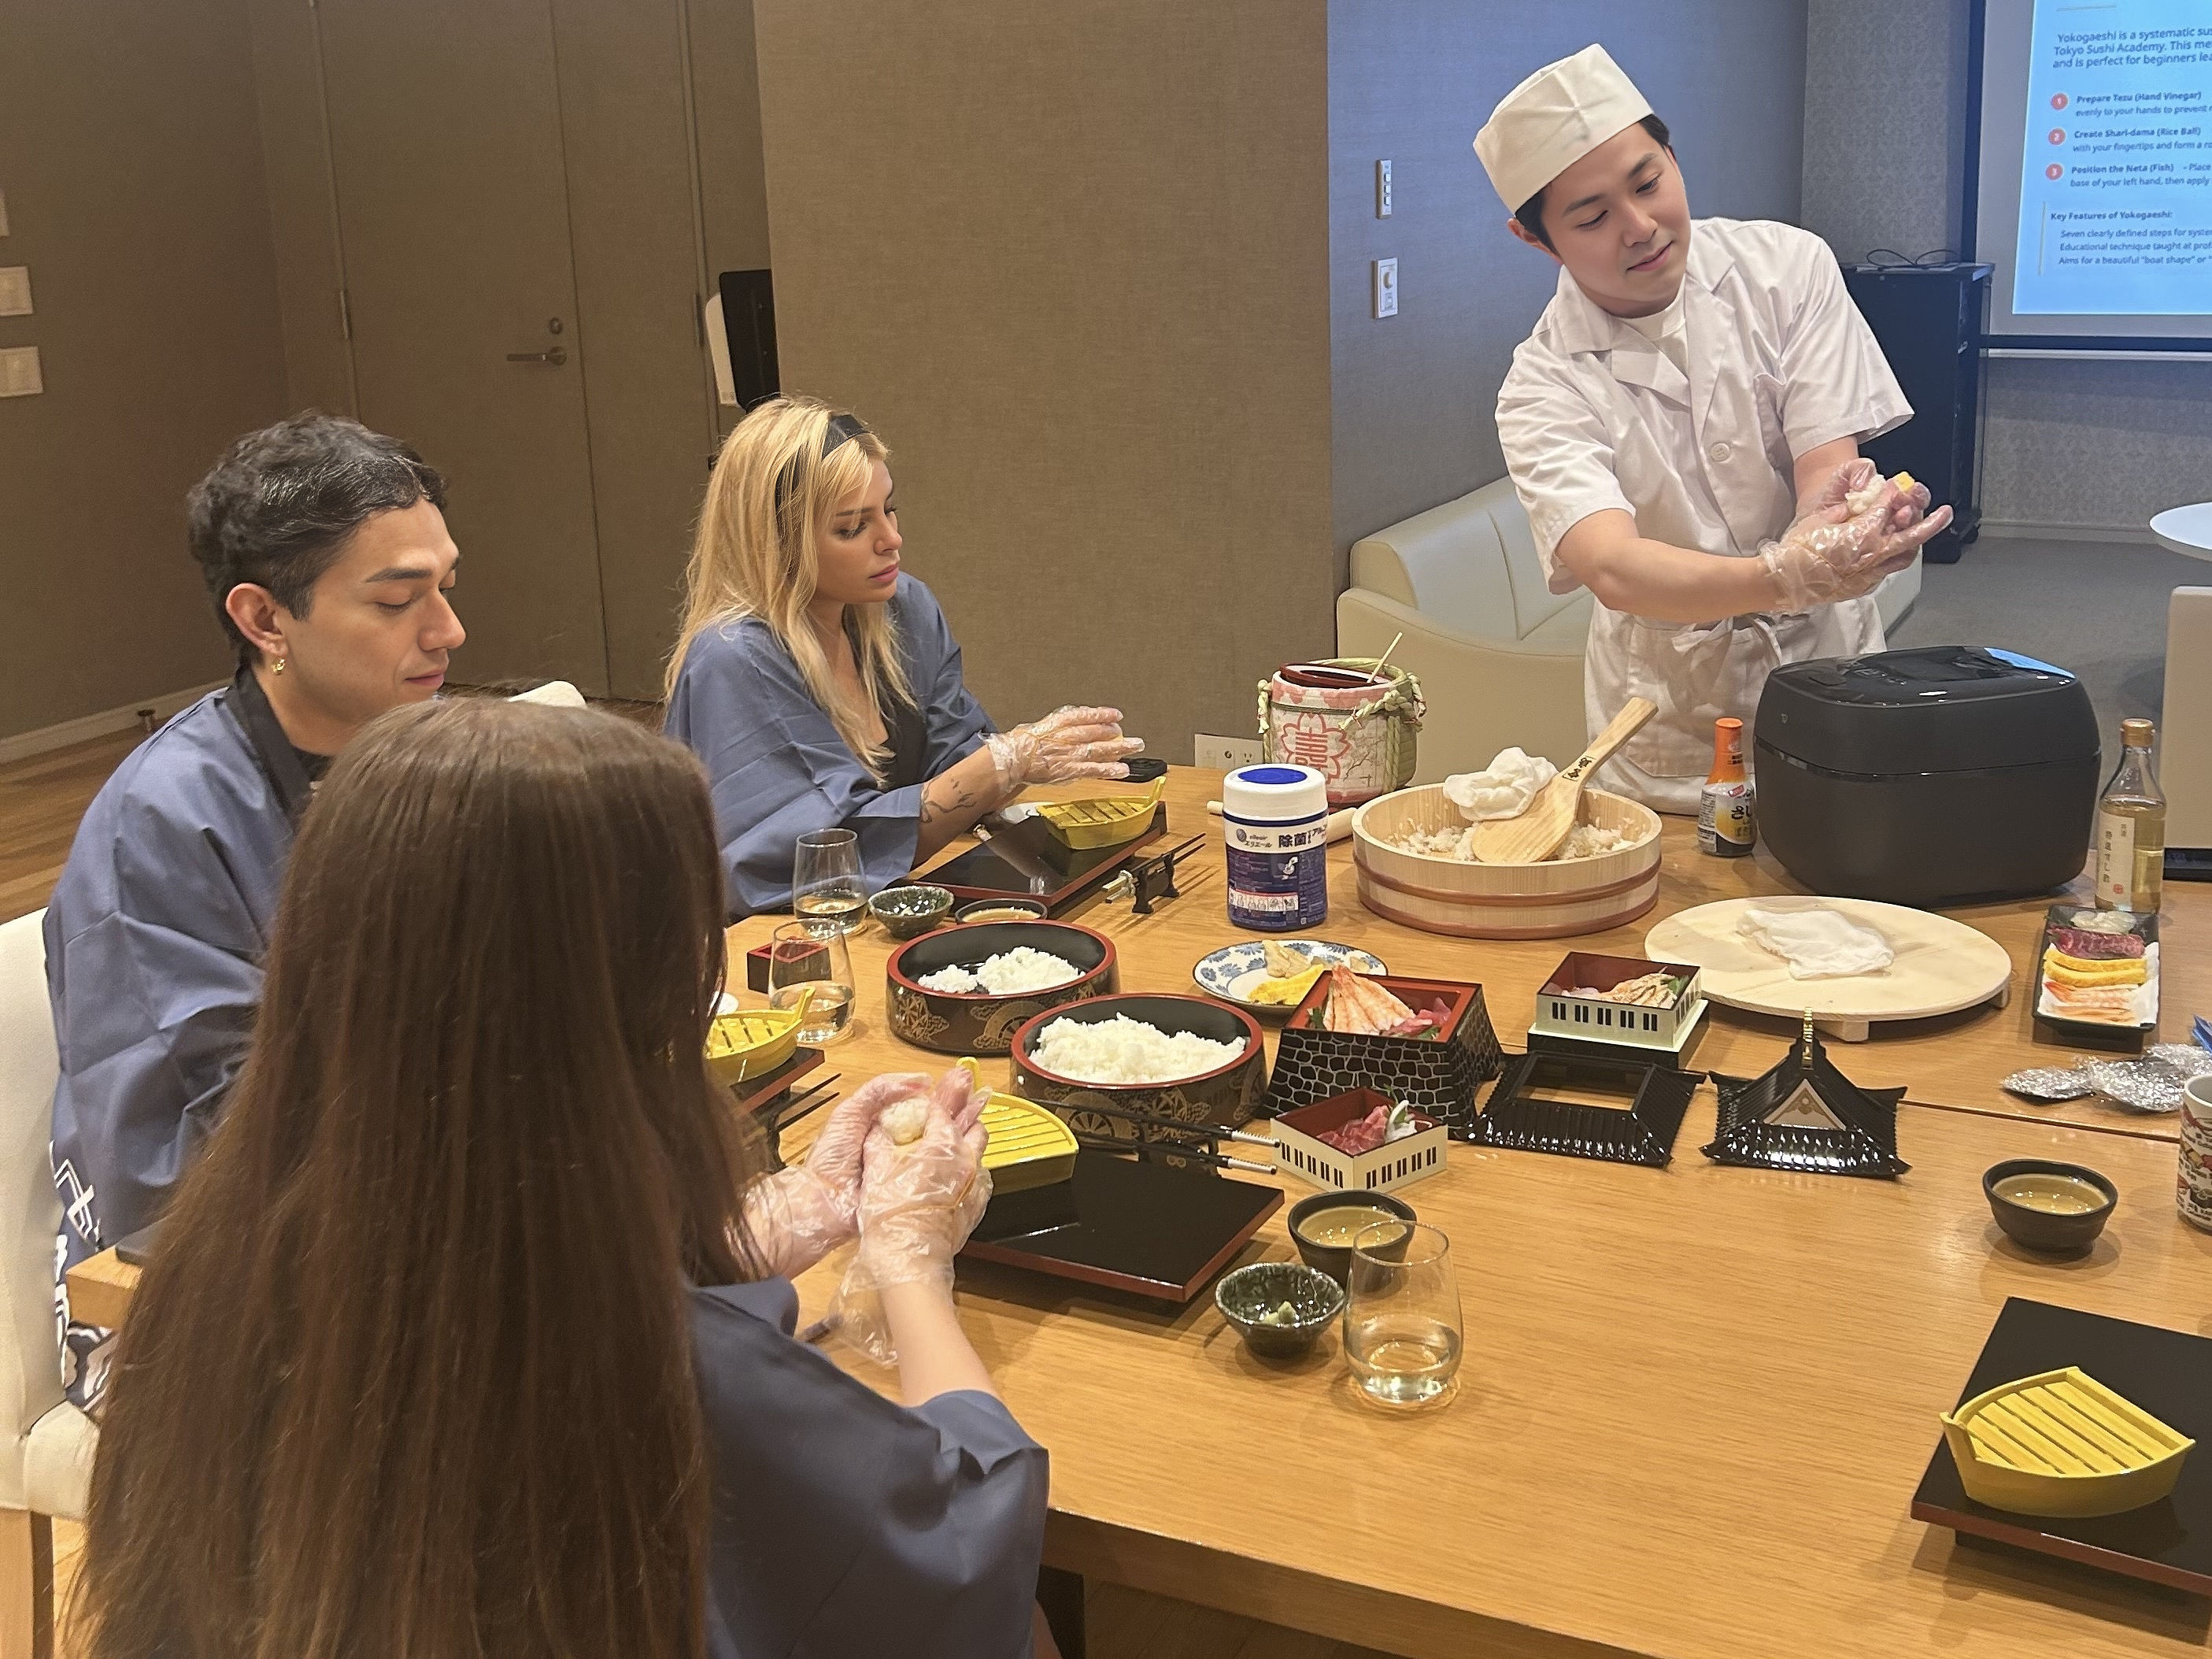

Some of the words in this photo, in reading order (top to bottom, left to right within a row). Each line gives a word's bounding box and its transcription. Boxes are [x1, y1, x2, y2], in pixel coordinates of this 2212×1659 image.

[2058, 31, 2117, 44] Yokogaeshi
[2139, 28, 2195, 41] systematic
[2054, 46, 2084, 57] Tokyo
[2087, 44, 2114, 54] Sushi
[2170, 40, 2192, 50] This
[2053, 58, 2073, 69] and
[2086, 56, 2123, 69] perfect
[2126, 55, 2140, 65] for
[2144, 53, 2196, 66] beginners
[2077, 95, 2110, 104] Prepare
[2135, 92, 2162, 102] (Hand
[2163, 91, 2202, 102] Vinegar)
[2114, 108, 2133, 118] your
[2136, 106, 2161, 114] hands
[2174, 106, 2206, 116] prevent
[2073, 130, 2103, 139] Create
[2073, 143, 2091, 152] with
[2092, 144, 2113, 154] your
[2174, 141, 2195, 150] form
[2072, 165, 2107, 174] Position
[2150, 163, 2174, 172] (Fish)
[2102, 179, 2121, 188] your
[2124, 177, 2136, 186] left
[2165, 176, 2184, 185] then
[2186, 176, 2210, 186] apply
[2051, 213, 2067, 221] Key
[2087, 229, 2114, 239] clearly
[2115, 228, 2147, 237] defined
[2150, 229, 2172, 238] steps
[2174, 228, 2187, 236] for
[2060, 243, 2108, 251] Educational
[2110, 243, 2151, 252] technique
[2153, 242, 2181, 251] taught
[2058, 256, 2079, 265] Aims
[2103, 255, 2140, 265] beautiful
